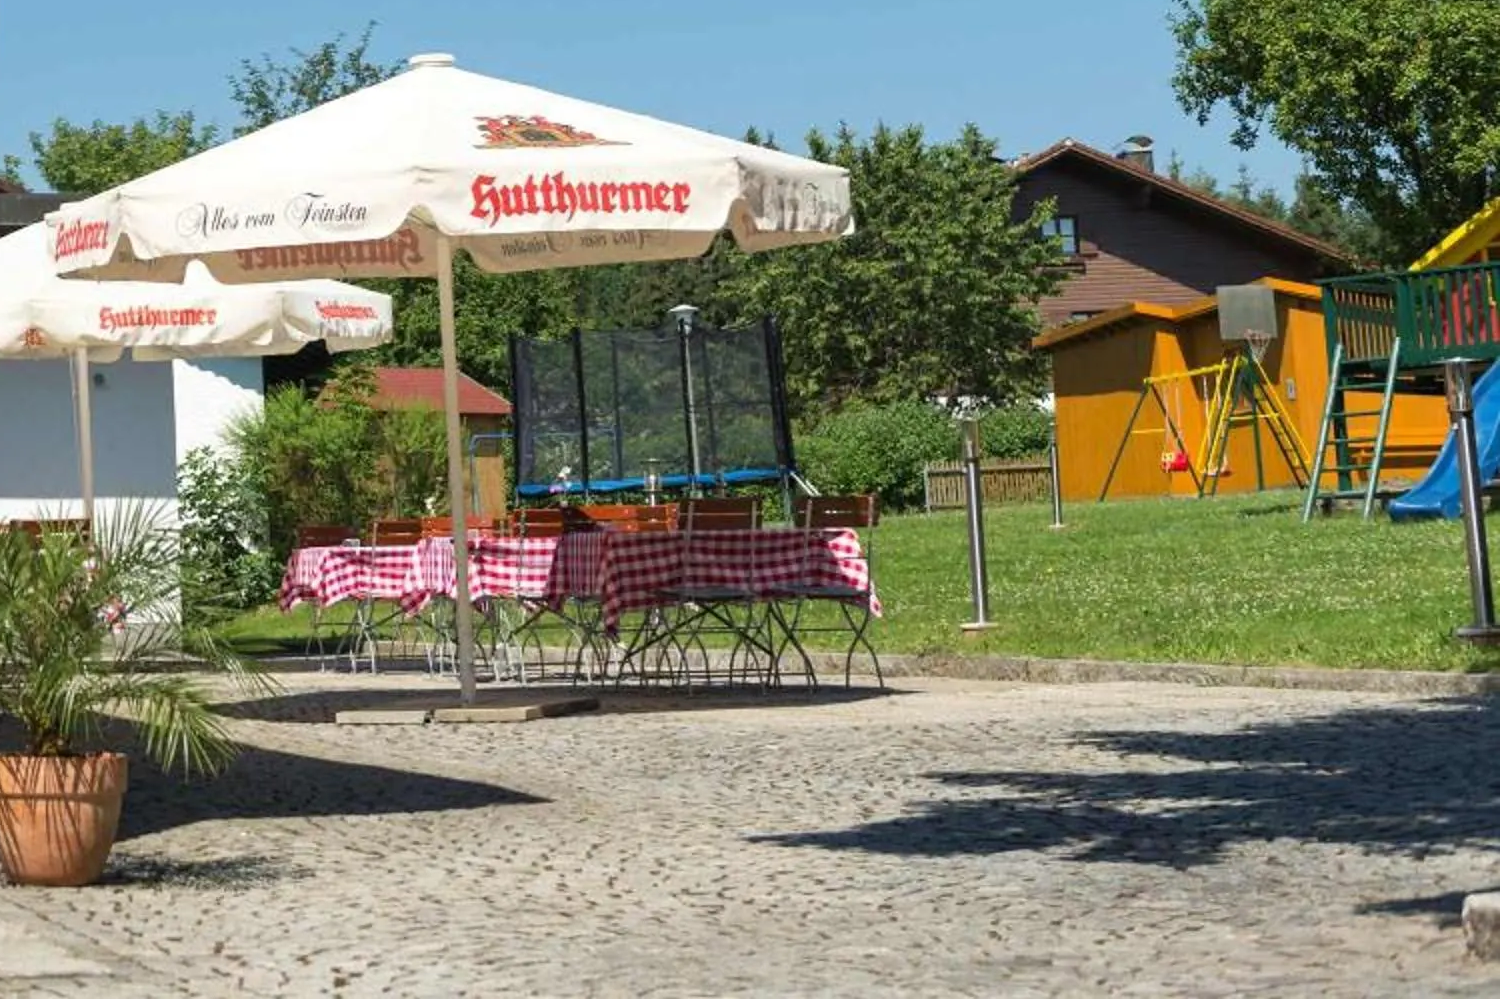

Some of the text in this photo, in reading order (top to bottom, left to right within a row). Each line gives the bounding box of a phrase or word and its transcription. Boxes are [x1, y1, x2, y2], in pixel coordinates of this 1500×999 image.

[176, 192, 367, 239] Alles vom Feinsten
[470, 171, 690, 227] Hutthurmer
